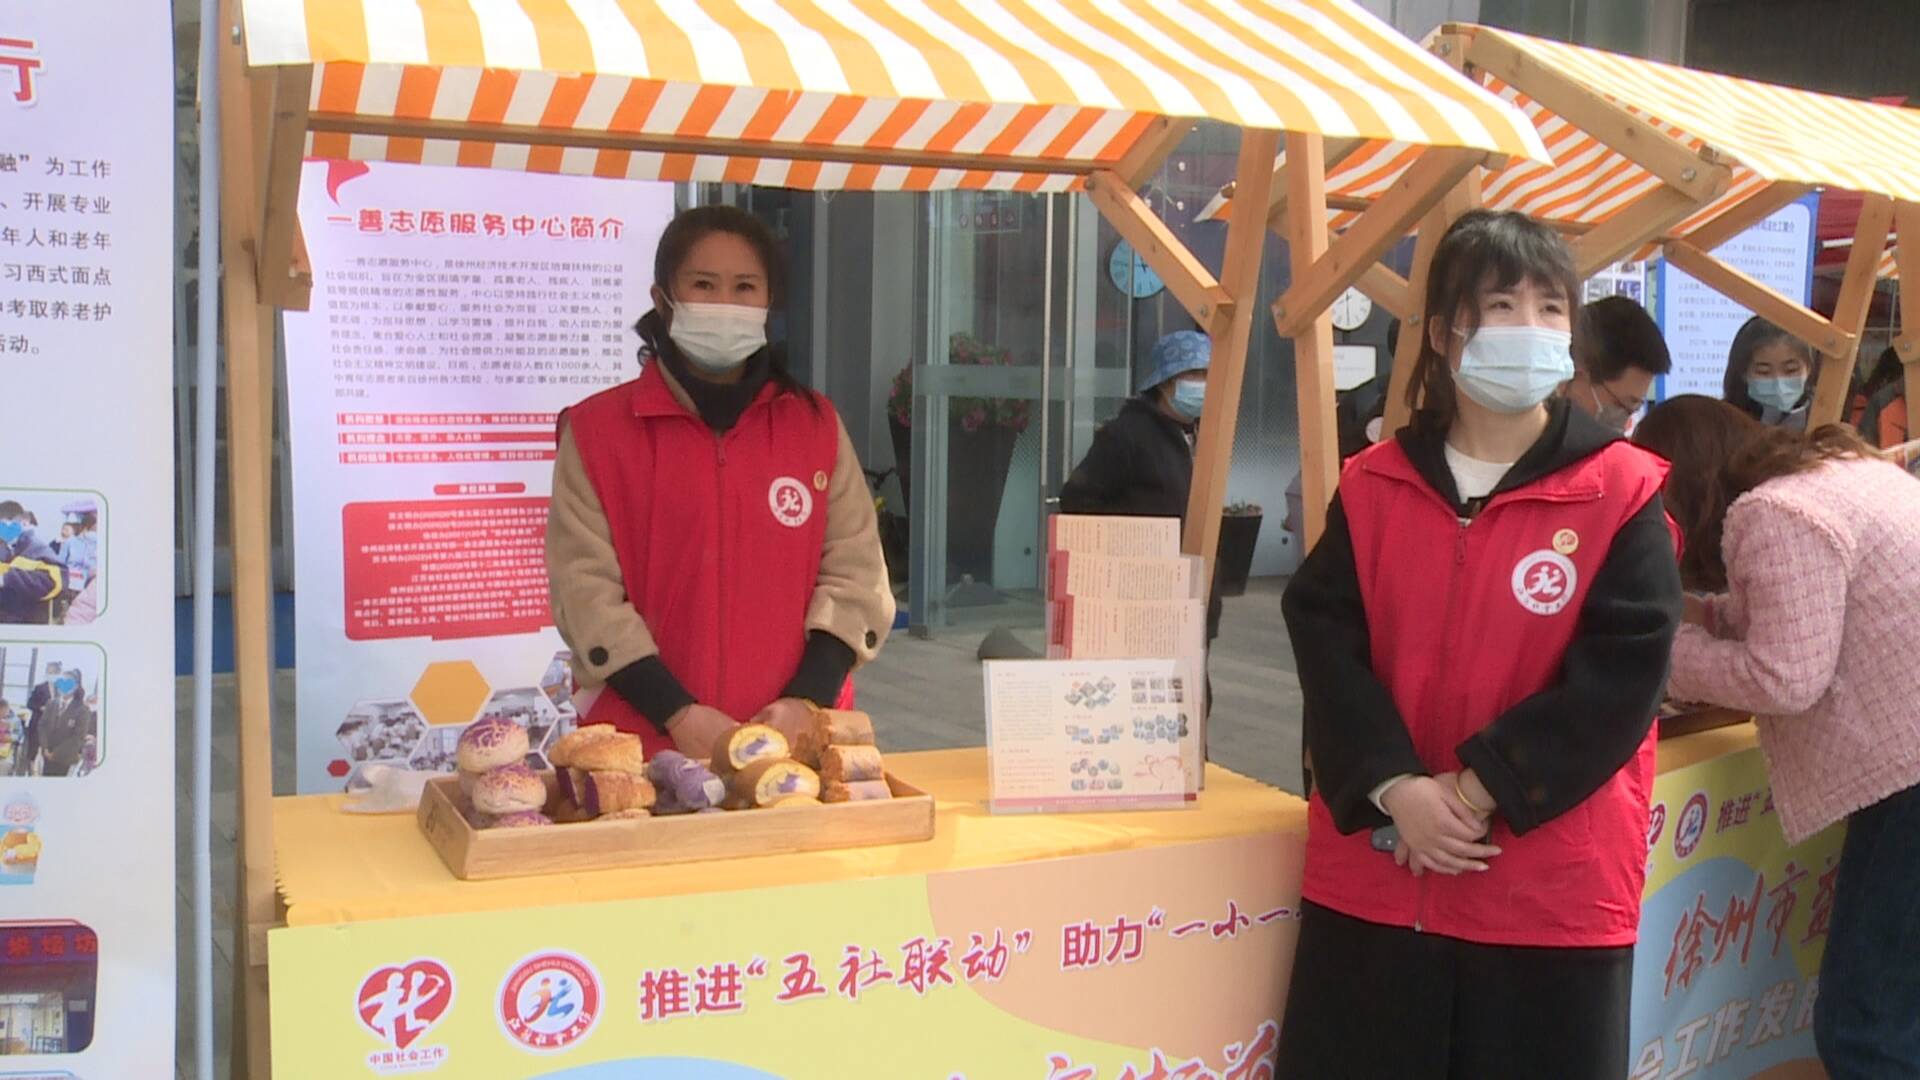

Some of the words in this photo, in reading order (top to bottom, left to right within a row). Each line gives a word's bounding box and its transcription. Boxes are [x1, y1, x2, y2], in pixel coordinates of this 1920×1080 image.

[327, 209, 624, 239] 一善志愿服务中心简介
[2, 226, 111, 250] 年人和老年
[4, 263, 111, 286] 习西式面点
[0, 298, 111, 321] 考取养老护
[1063, 902, 1302, 968] 助力“一小一
[370, 1048, 445, 1064] 中国社会工作
